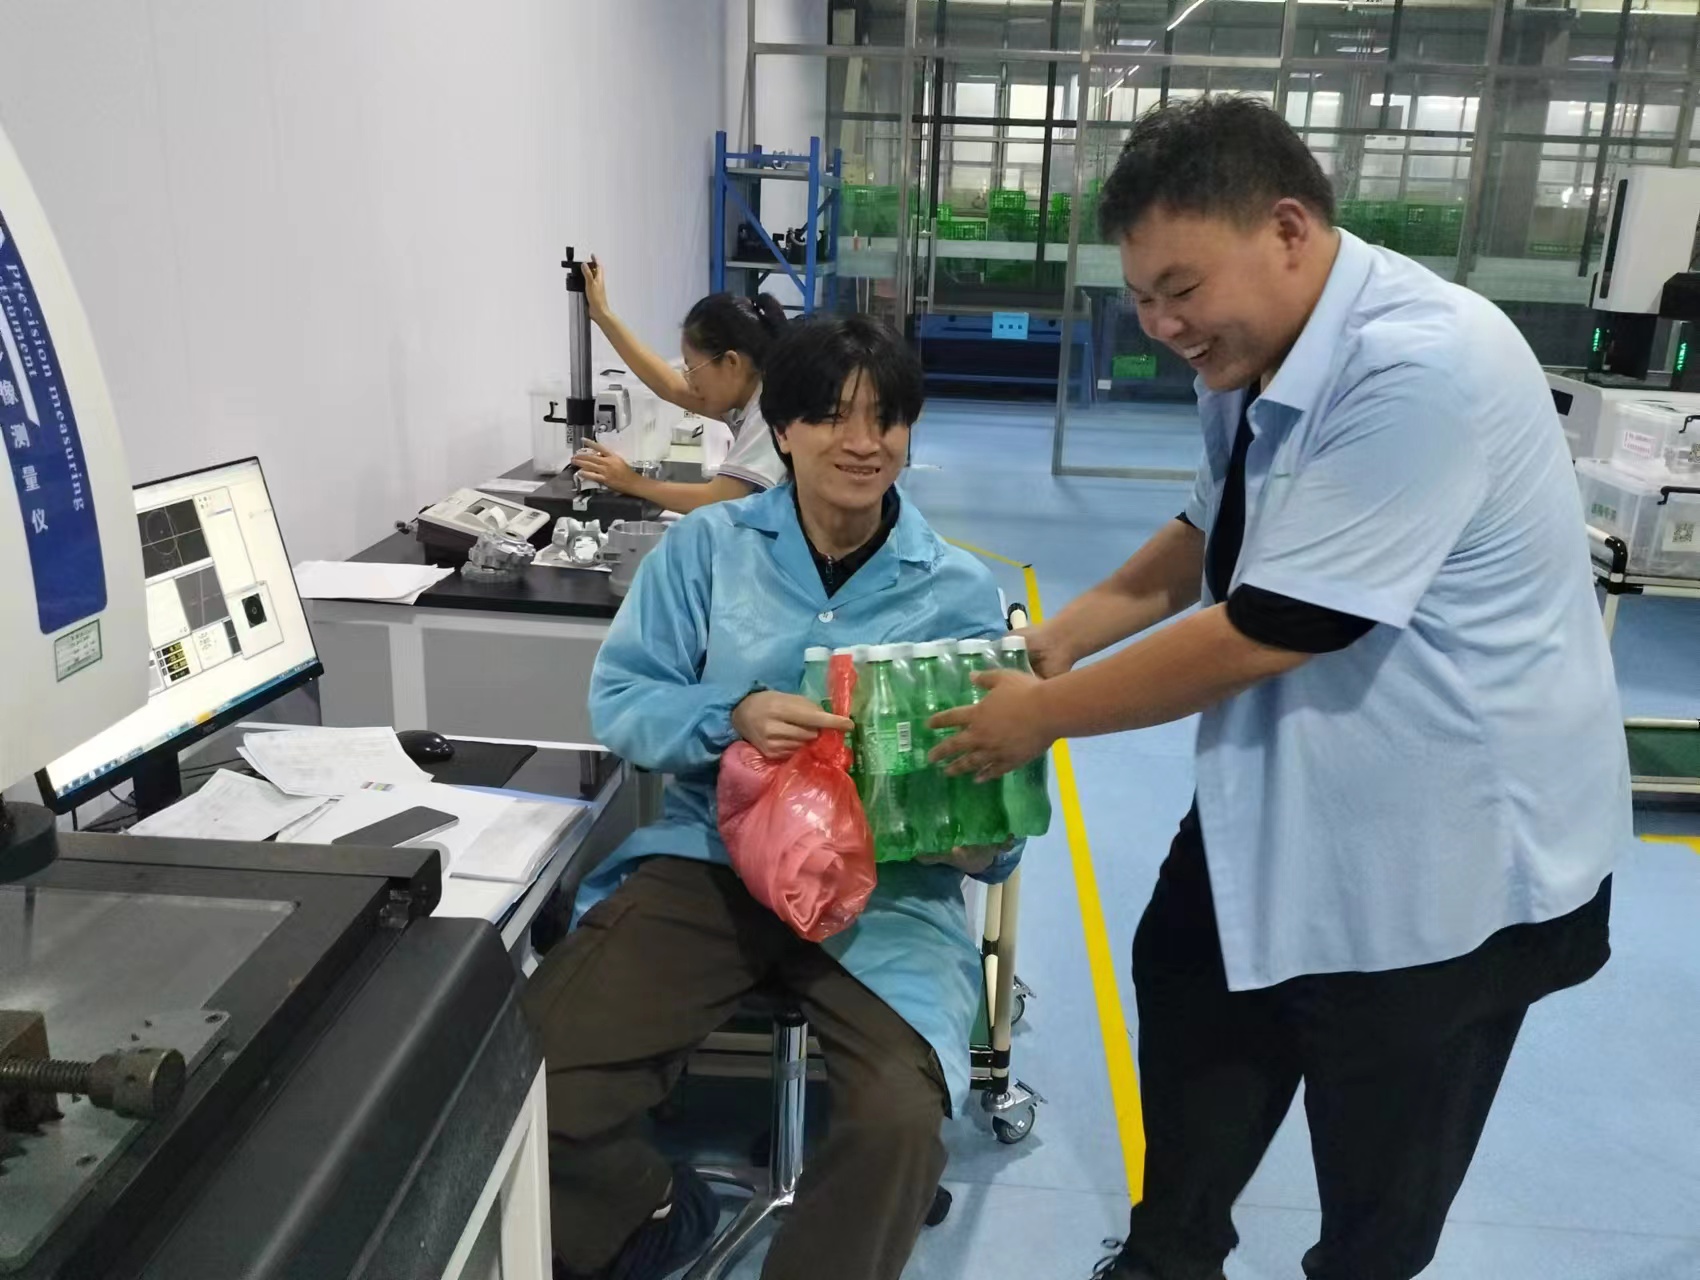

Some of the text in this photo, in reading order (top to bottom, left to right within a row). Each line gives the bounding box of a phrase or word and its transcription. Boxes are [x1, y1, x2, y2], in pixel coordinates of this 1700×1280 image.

[0, 351, 49, 534] 像测量仪
[6, 264, 85, 512] Precision measuring
